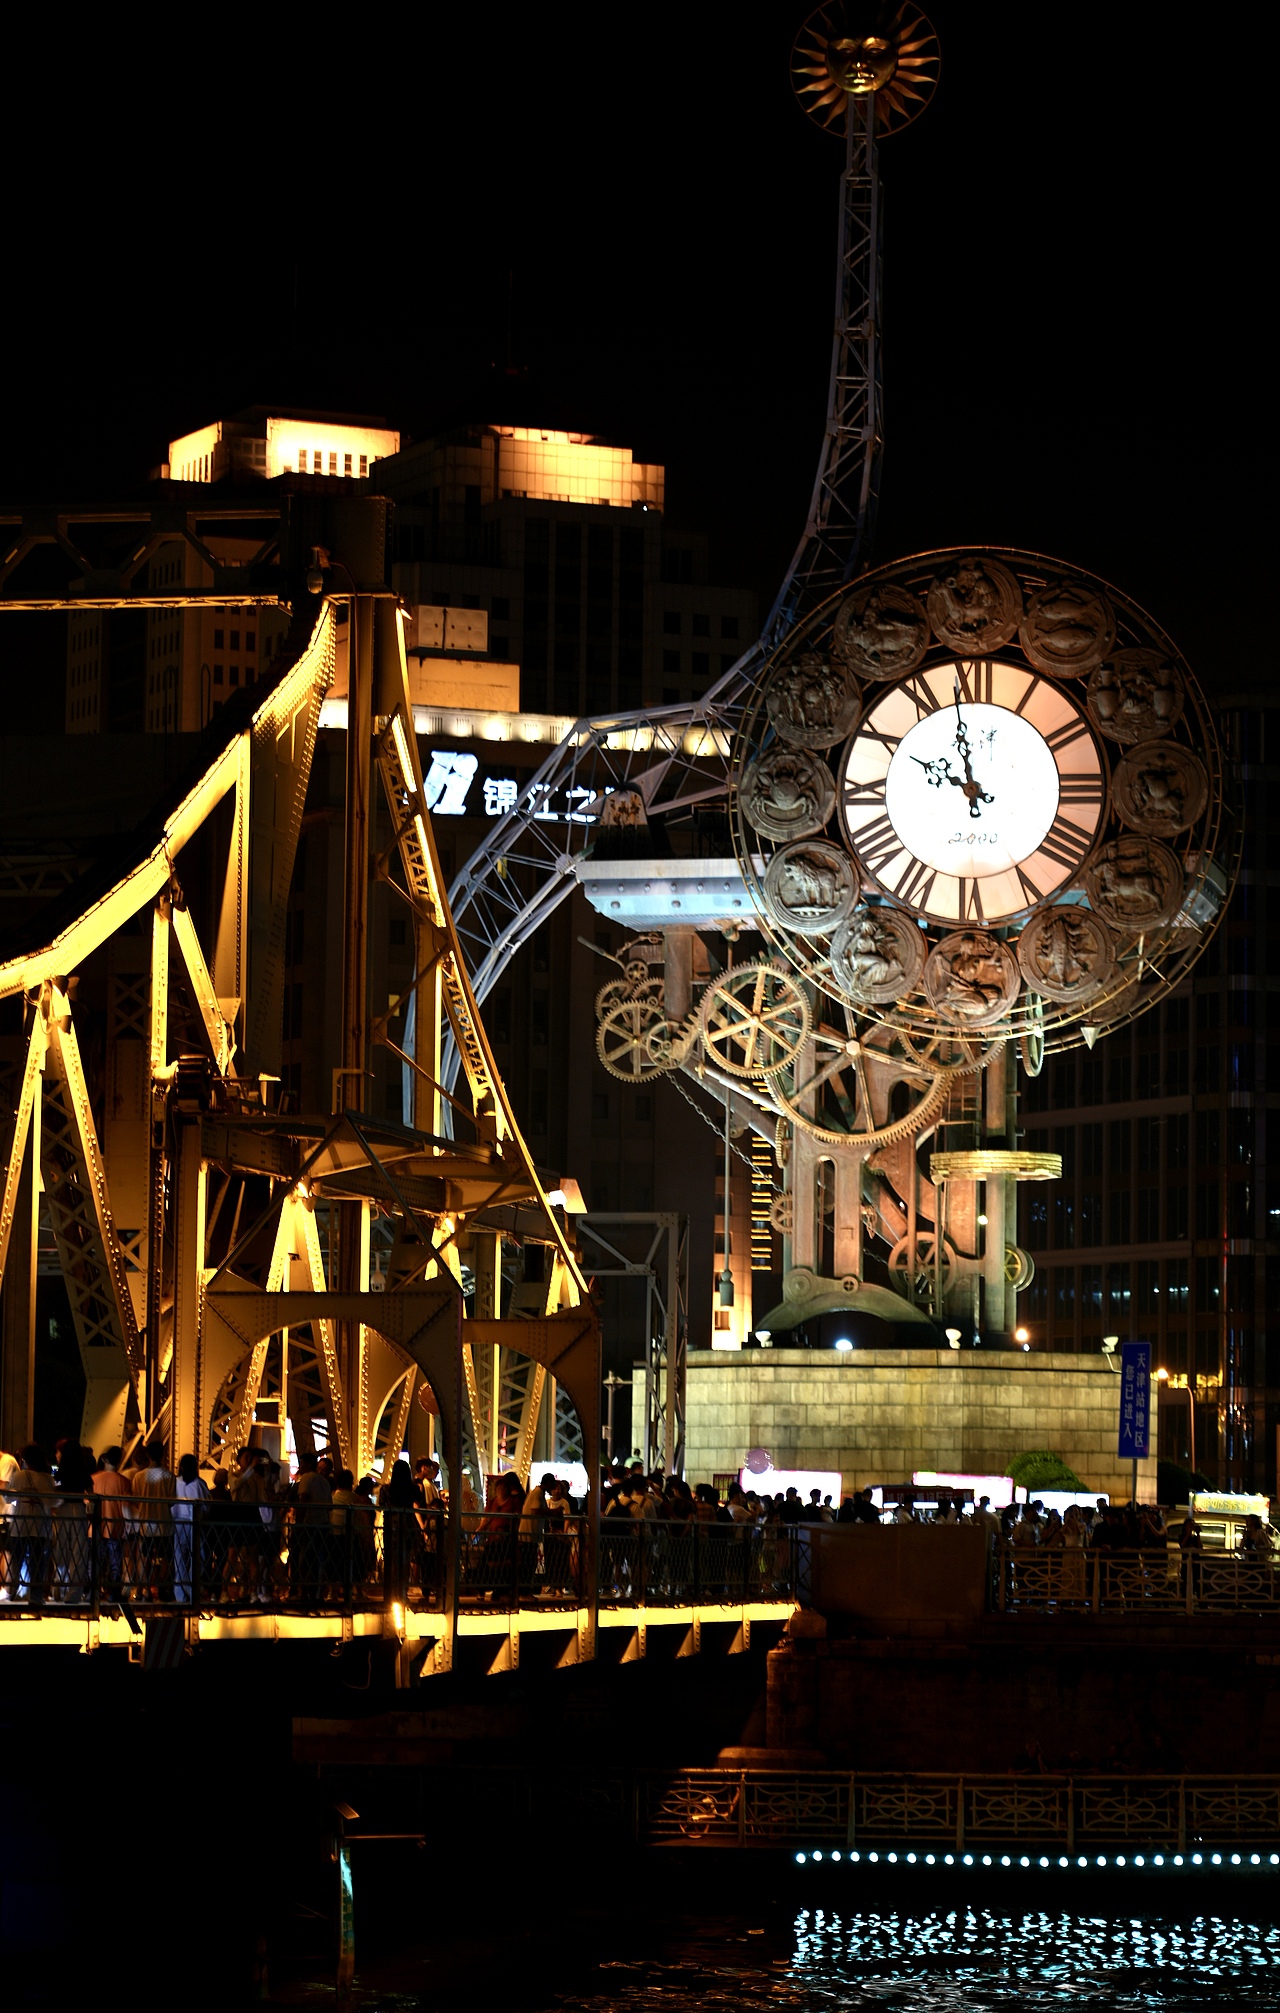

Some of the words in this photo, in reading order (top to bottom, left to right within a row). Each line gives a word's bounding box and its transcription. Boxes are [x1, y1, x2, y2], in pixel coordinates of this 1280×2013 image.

[859, 719, 903, 757] X
[483, 777, 615, 824] 锦江之
[1059, 773, 1103, 804] III
[948, 832, 998, 845] 2000
[1123, 1364, 1135, 1439] 您已进入
[1134, 1353, 1146, 1448] 天津站地区
